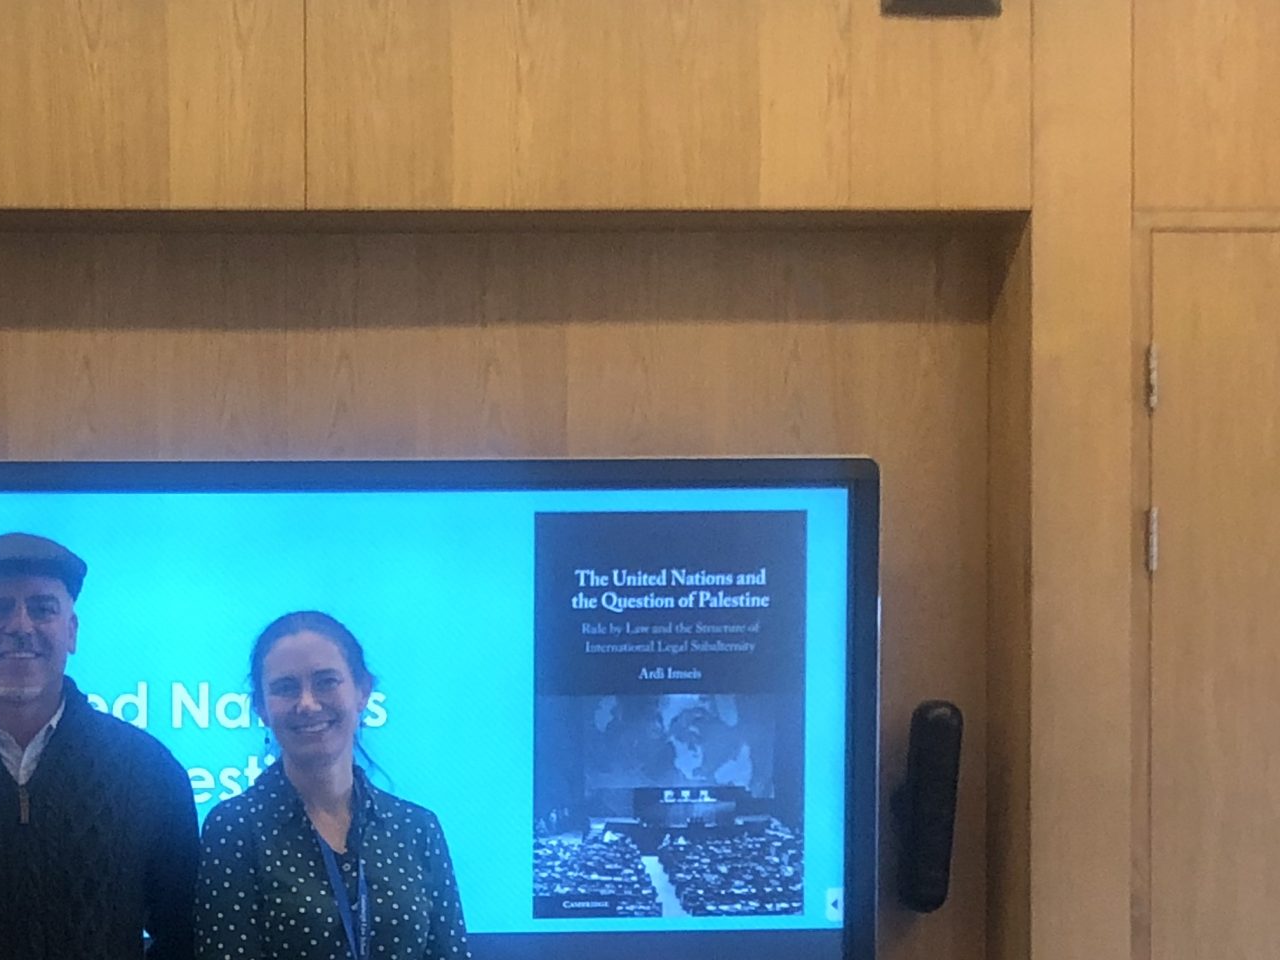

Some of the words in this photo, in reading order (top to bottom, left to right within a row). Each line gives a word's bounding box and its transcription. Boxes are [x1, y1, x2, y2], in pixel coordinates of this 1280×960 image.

[574, 569, 609, 587] The
[612, 569, 667, 586] United
[670, 568, 733, 586] Nations
[736, 567, 766, 585] and
[571, 591, 598, 609] the
[601, 591, 675, 613] Question
[678, 590, 698, 608] of
[699, 590, 770, 608] Palestine
[582, 622, 607, 635] Rule
[609, 622, 623, 637] by
[625, 621, 650, 634] Law
[651, 621, 673, 634] and
[675, 621, 694, 634] the
[695, 621, 746, 634] Structure
[747, 621, 760, 633] of
[585, 641, 655, 653] International
[657, 640, 688, 655] Legal
[638, 667, 665, 679] Ardi
